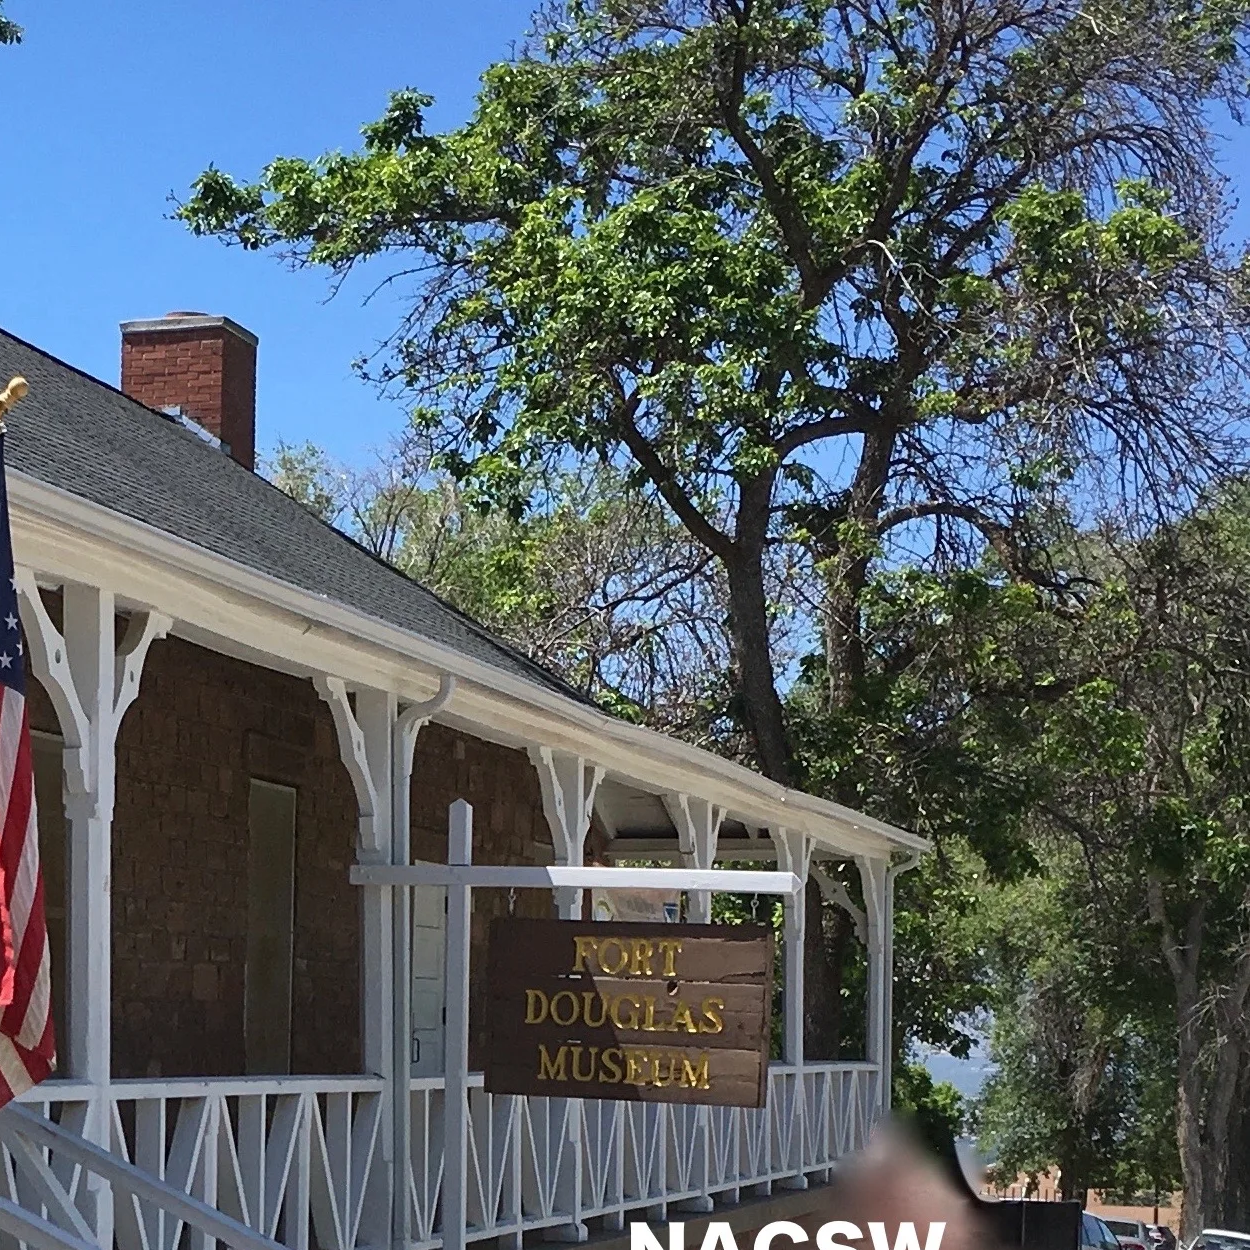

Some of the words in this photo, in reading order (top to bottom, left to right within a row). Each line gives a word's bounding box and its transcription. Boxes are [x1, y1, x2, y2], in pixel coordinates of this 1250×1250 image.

[573, 936, 682, 977] FORT
[524, 989, 725, 1034] DOUGLAS
[537, 1044, 710, 1090] MUSEUM
